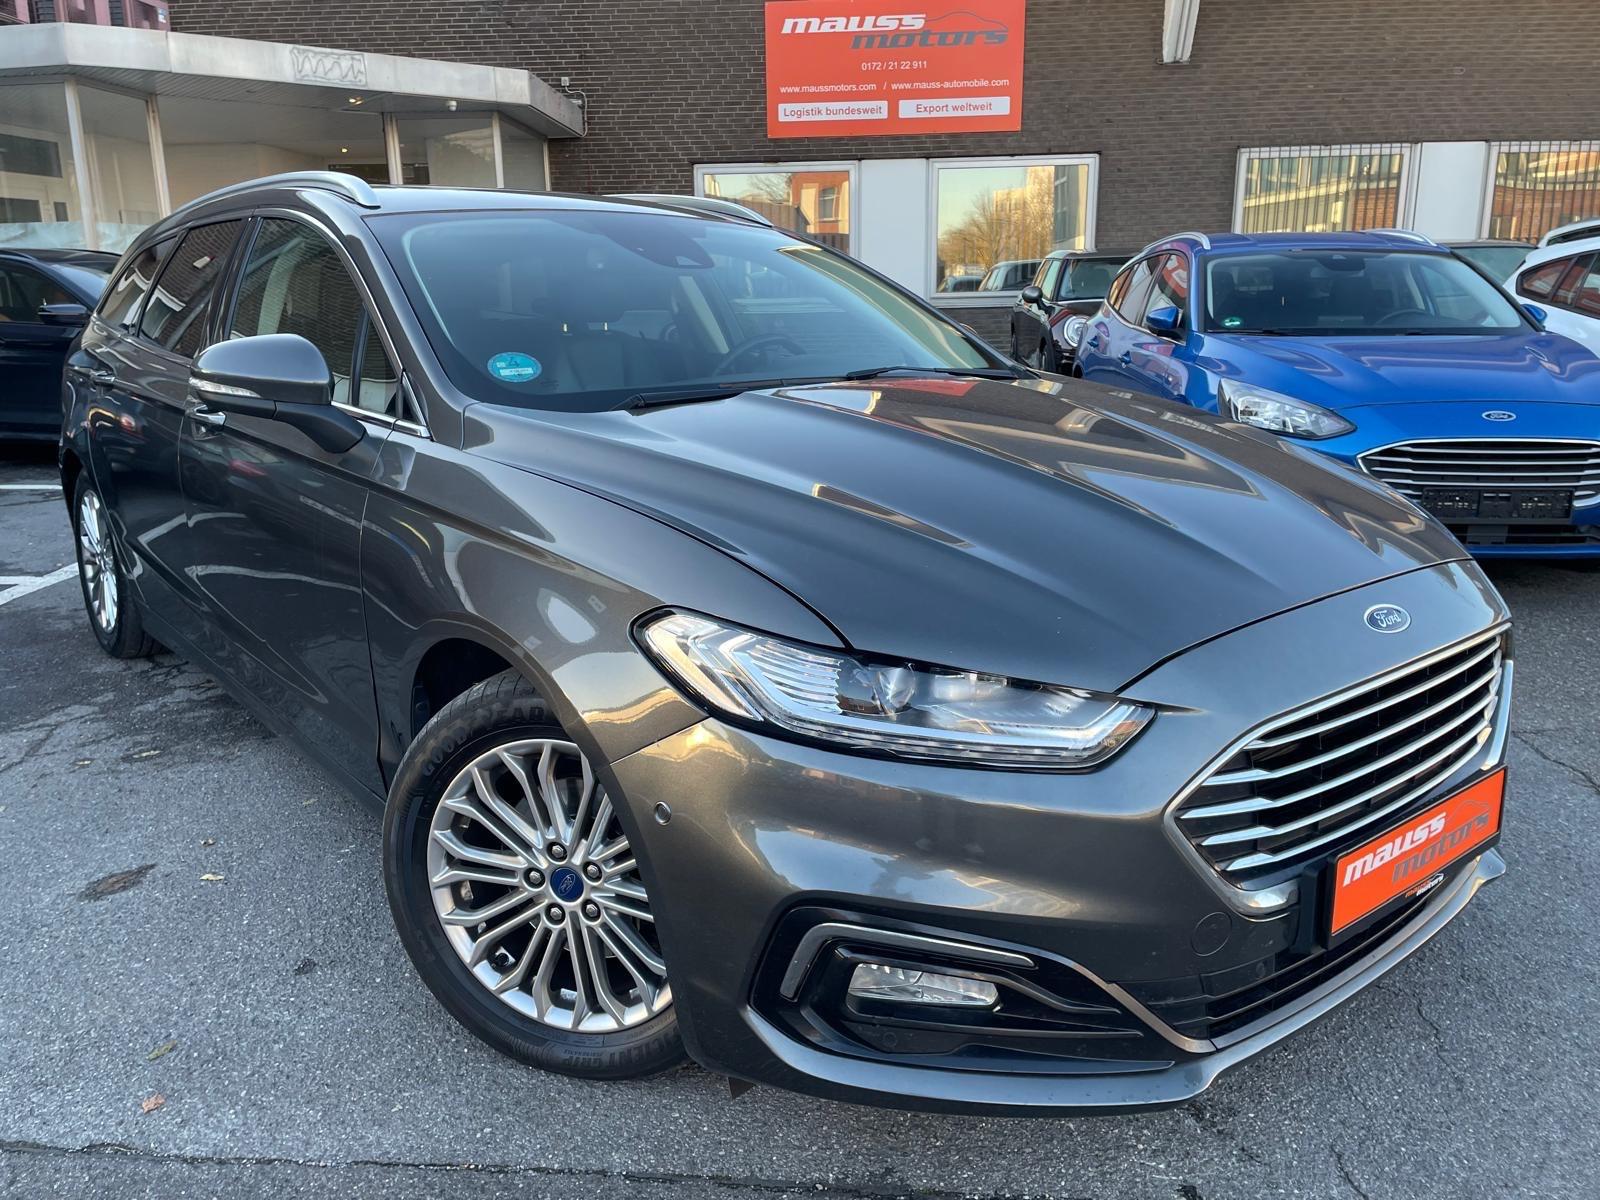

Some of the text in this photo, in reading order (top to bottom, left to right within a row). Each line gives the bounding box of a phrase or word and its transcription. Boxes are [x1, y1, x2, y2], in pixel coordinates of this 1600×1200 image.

[781, 14, 926, 34] mauss
[851, 30, 1008, 49] motors
[861, 61, 882, 71] 0172
[888, 61, 898, 70] 21
[900, 60, 911, 70] 22
[912, 60, 927, 69] 911
[780, 82, 876, 93] www.maussmotors.com
[891, 78, 1009, 90] www.mauss-automobile.com
[783, 105, 882, 119] Logistik bundesweit
[916, 101, 993, 114] Export weltweit
[1343, 812, 1447, 887] mauss
[1392, 812, 1490, 884] motors
